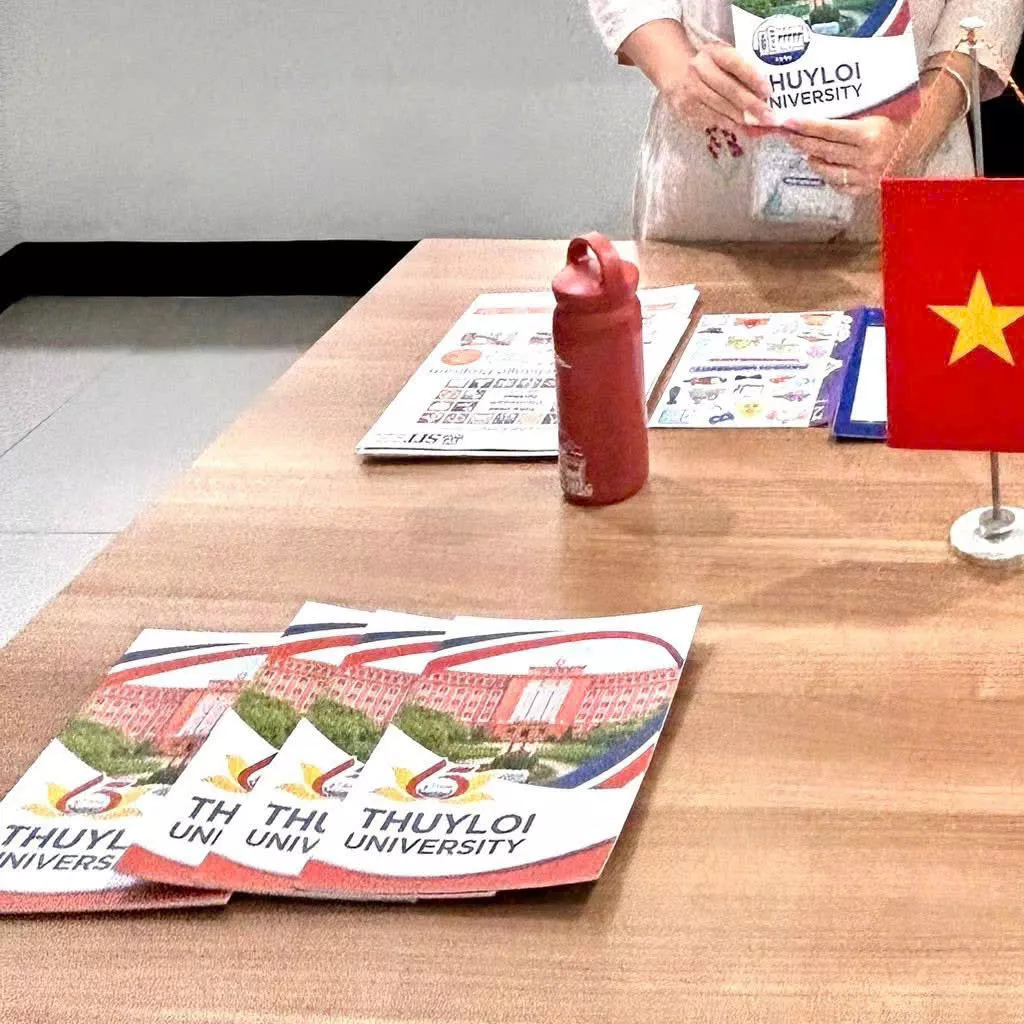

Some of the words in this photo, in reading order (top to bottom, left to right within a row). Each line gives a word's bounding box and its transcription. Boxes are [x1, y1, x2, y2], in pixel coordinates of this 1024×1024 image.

[769, 62, 861, 92] HUYLOI
[769, 83, 862, 109] NIVERSITY
[361, 807, 537, 835] THUYLOI
[2, 825, 129, 850] THUYL
[344, 832, 527, 855] UNIVERSITY
[0, 853, 116, 871] NIVERS
